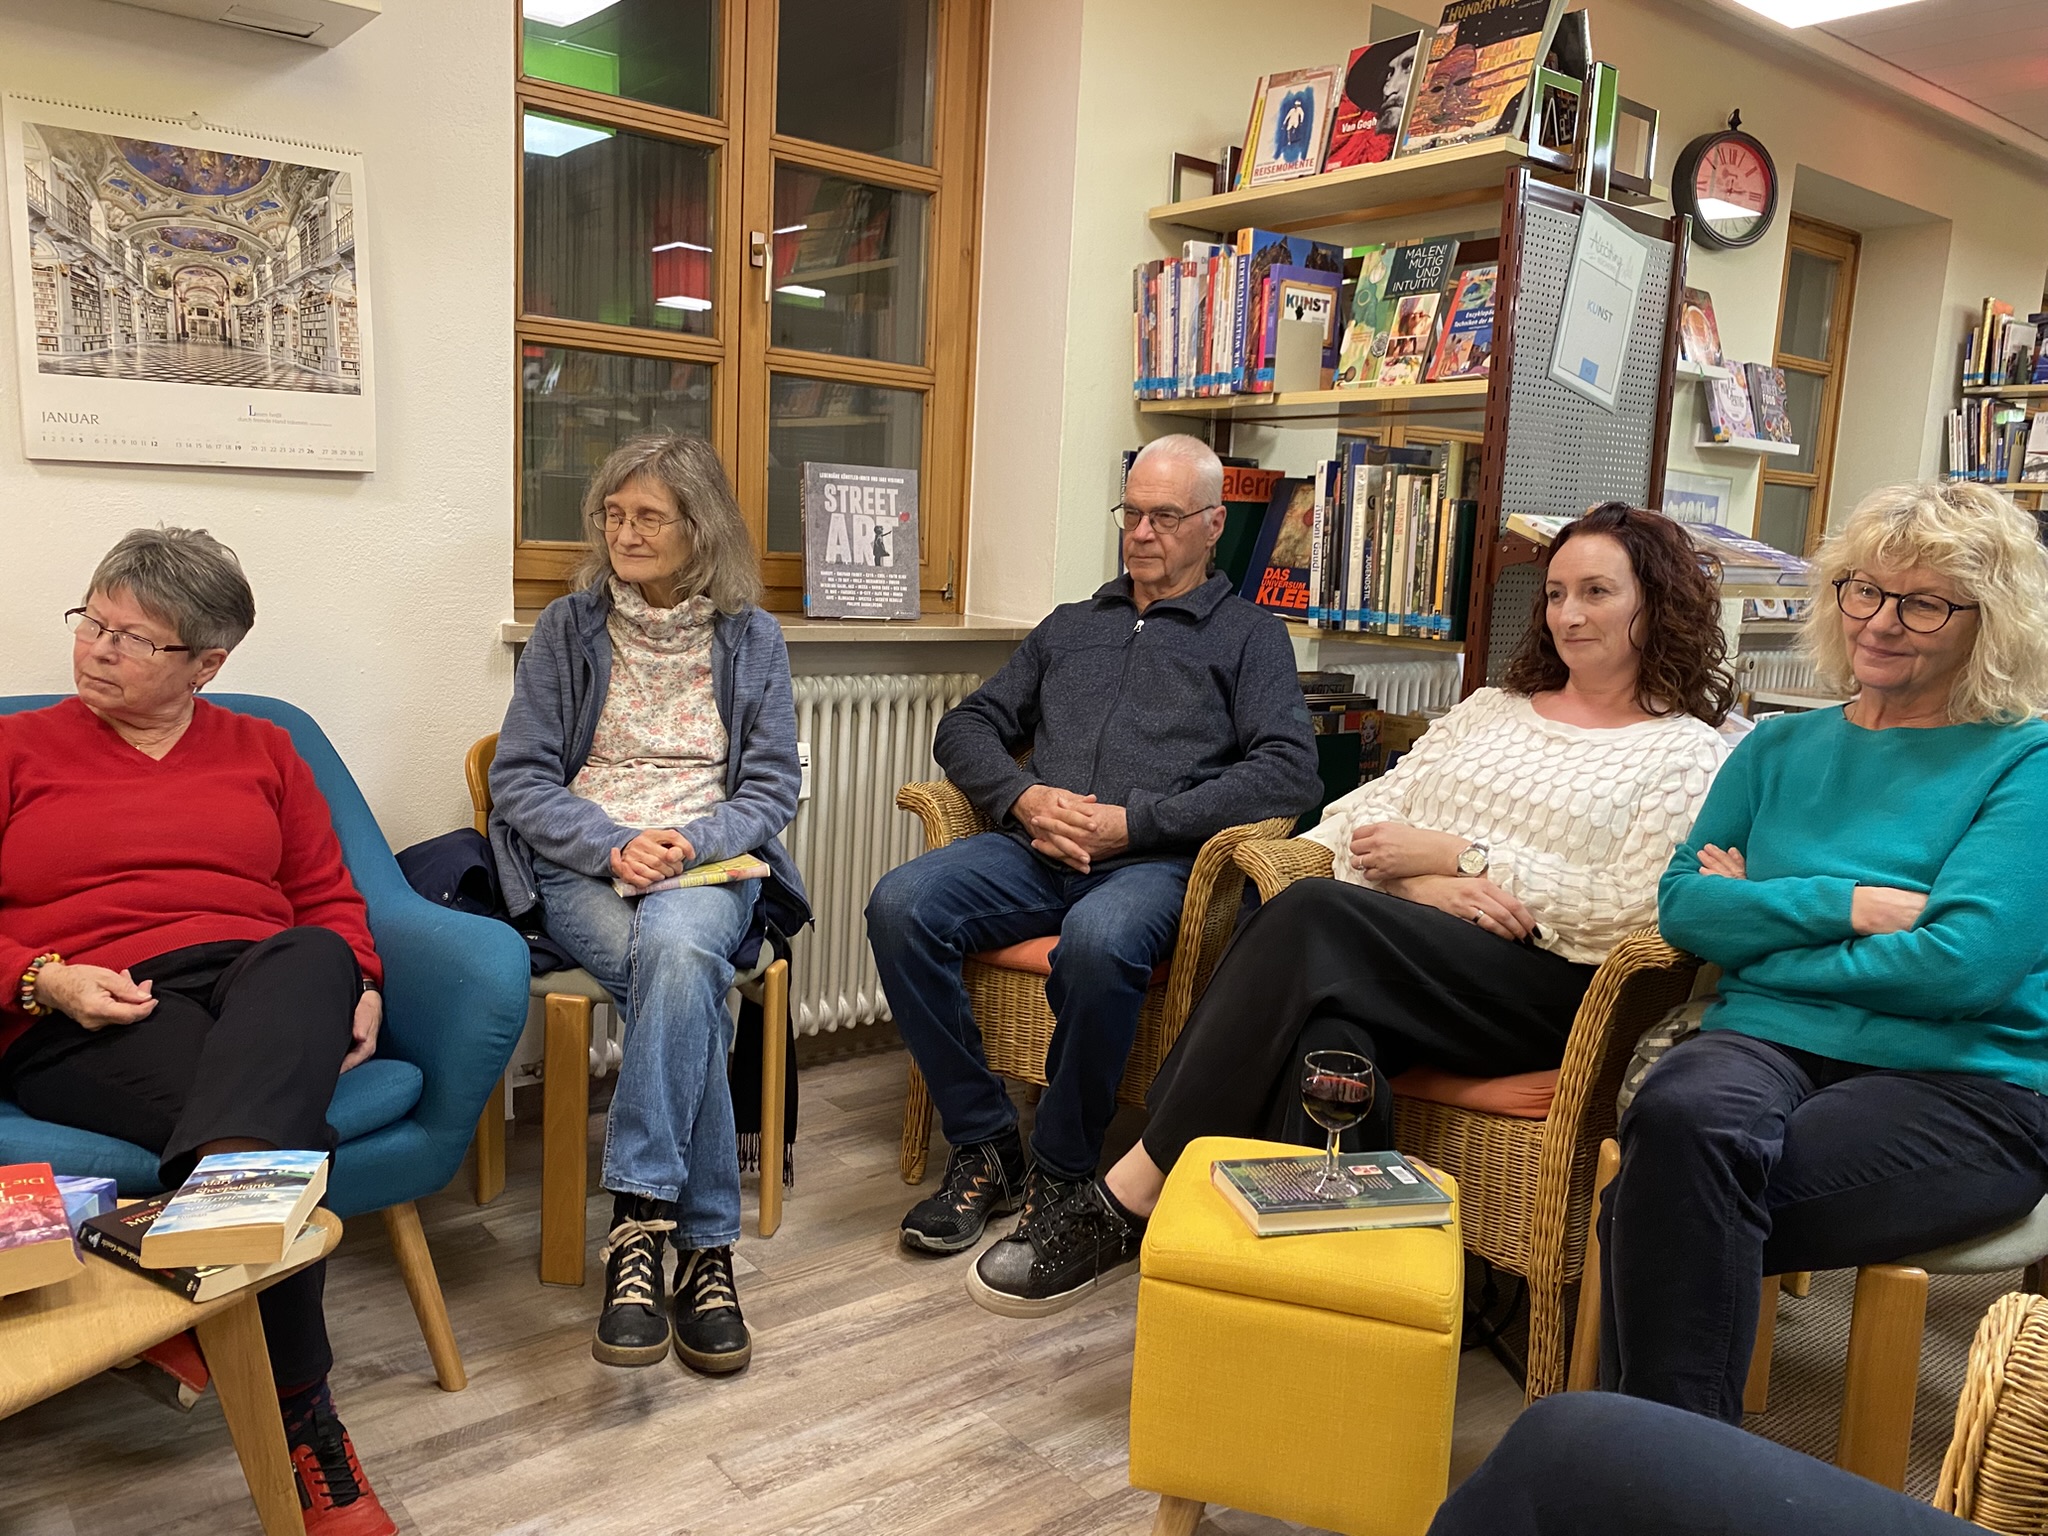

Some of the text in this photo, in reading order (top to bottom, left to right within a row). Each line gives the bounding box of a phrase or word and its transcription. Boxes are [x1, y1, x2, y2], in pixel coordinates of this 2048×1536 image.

[1341, 116, 1378, 133] Van Gogh
[1254, 158, 1314, 177] REISEMOMENTE
[1405, 244, 1448, 260] MALEN!
[1408, 255, 1444, 270] MUTIG
[1415, 266, 1441, 279] UND
[1392, 277, 1440, 292] INTUITIV
[1286, 294, 1330, 313] KUNST
[1586, 299, 1614, 324] KUNST
[42, 411, 100, 425] JANUAR
[1222, 469, 1277, 497] aleri
[824, 483, 899, 516] STREET
[1312, 504, 1324, 540] Antoni
[825, 513, 899, 567] ART
[1262, 567, 1291, 581] DAS
[1363, 554, 1373, 602] JUGENDSTIL
[1261, 579, 1307, 591] UNIVERSUM
[1255, 586, 1311, 609] KLEE
[13, 1177, 45, 1186] Die
[195, 1182, 276, 1195] Sheepshanks
[200, 1178, 235, 1188] Mary
[0, 1193, 34, 1205] Ch
[126, 1210, 163, 1227] Mörd
